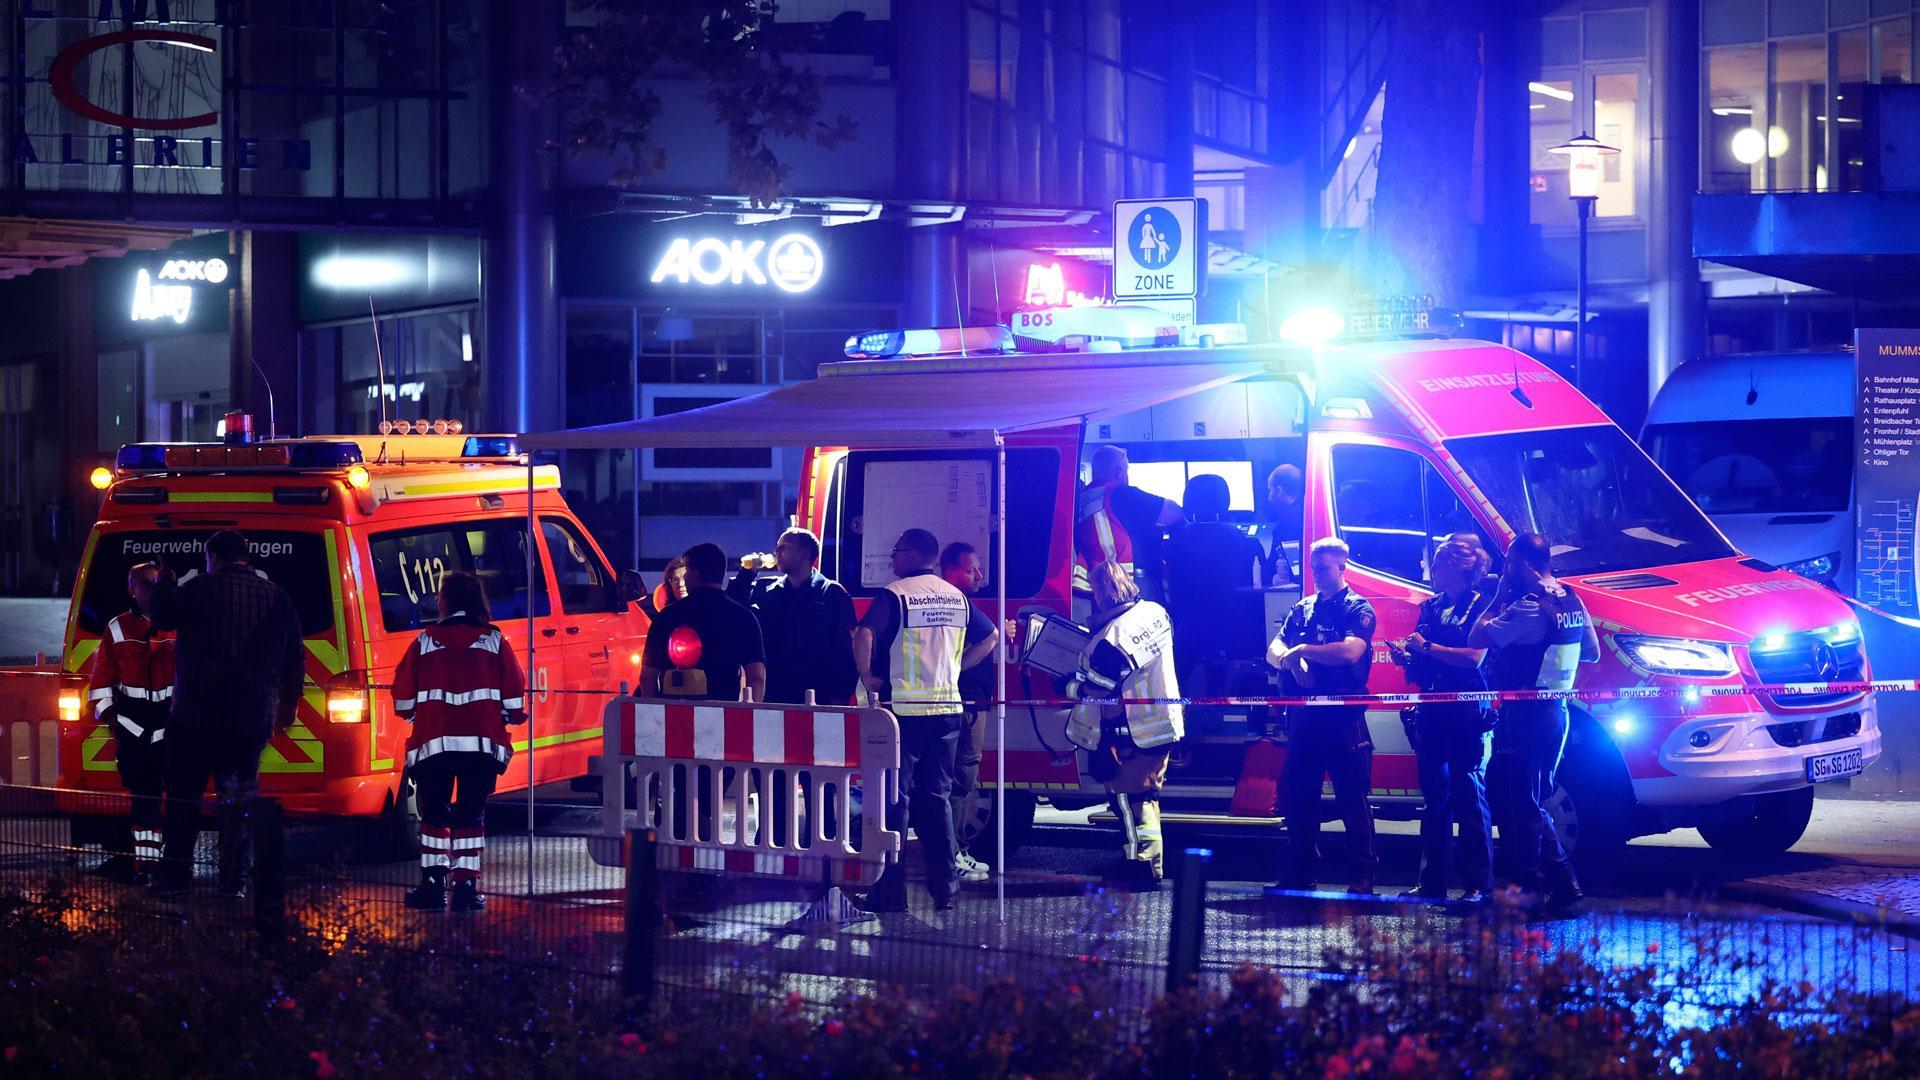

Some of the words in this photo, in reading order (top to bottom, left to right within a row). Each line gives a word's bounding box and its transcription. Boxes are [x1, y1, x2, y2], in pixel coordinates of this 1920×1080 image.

[651, 238, 767, 284] AOK
[158, 260, 206, 280] AOK
[1135, 274, 1174, 290] ZONE
[1021, 313, 1053, 327] BOS
[1879, 346, 1920, 356] MUMM
[1419, 371, 1560, 393] EINSATZLEITUNG
[1874, 397, 1916, 405] Rathausplatz
[1874, 407, 1909, 415] Entenpfuhl
[1143, 433, 1151, 441] 12
[1874, 438, 1913, 446] Mühlenplatz
[1873, 448, 1897, 456] Ohliger
[1899, 448, 1909, 456] Tor
[1674, 579, 1822, 607] FEUERWEHR
[909, 594, 962, 606] Abschnittsleiter
[1814, 759, 1826, 776] SG
[1831, 756, 1842, 773] SG
[1843, 752, 1861, 772] 1202
